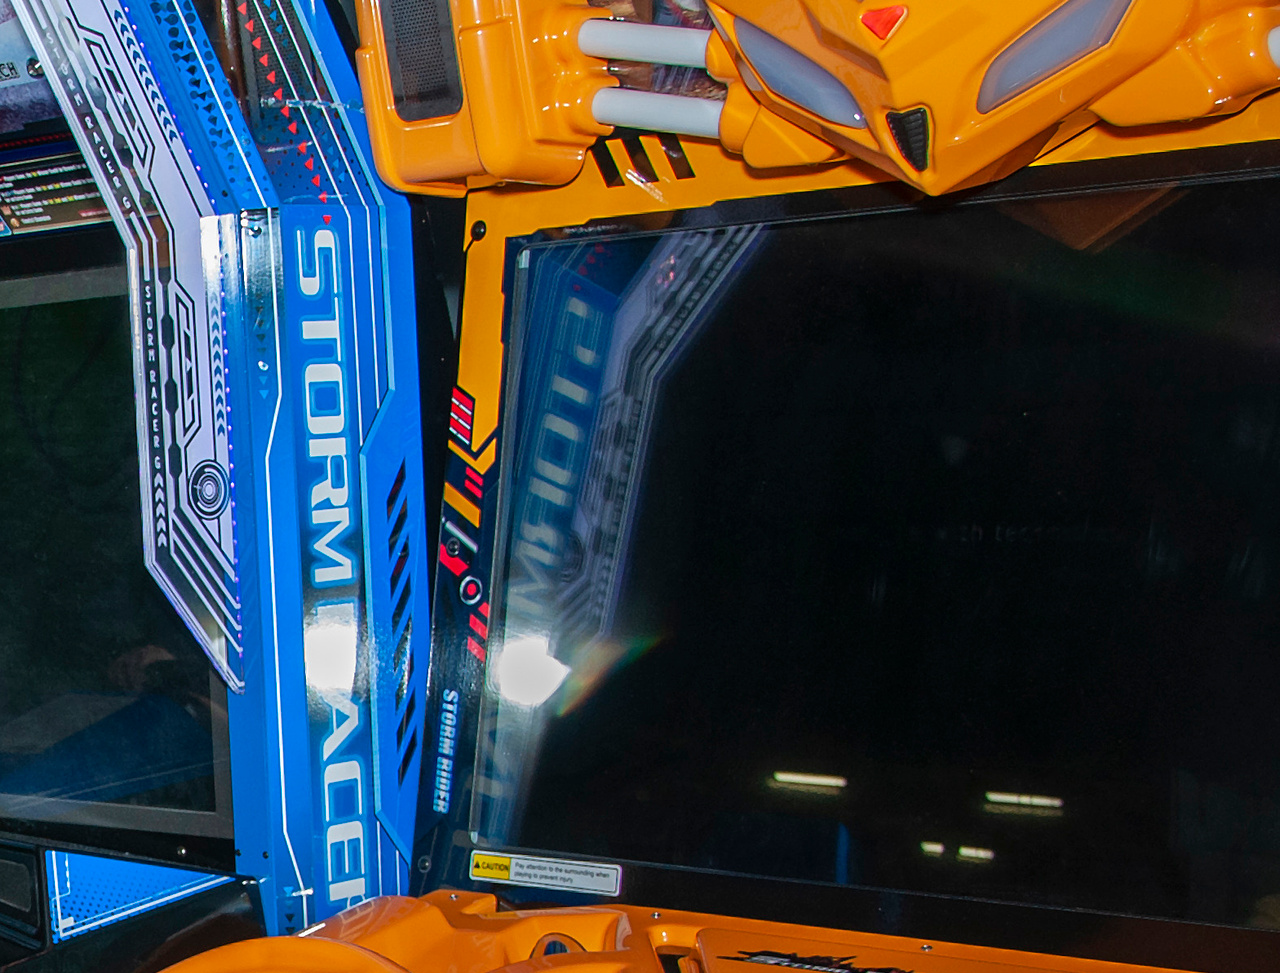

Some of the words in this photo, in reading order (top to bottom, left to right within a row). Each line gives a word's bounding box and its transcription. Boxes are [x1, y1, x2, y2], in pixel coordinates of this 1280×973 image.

[84, 116, 122, 190] RACER
[144, 285, 156, 362] STORM
[149, 369, 160, 448] RACER
[297, 229, 353, 583] STORM
[438, 689, 459, 756] STORM
[433, 757, 453, 814] RIDER
[481, 861, 509, 872] CAUTION
